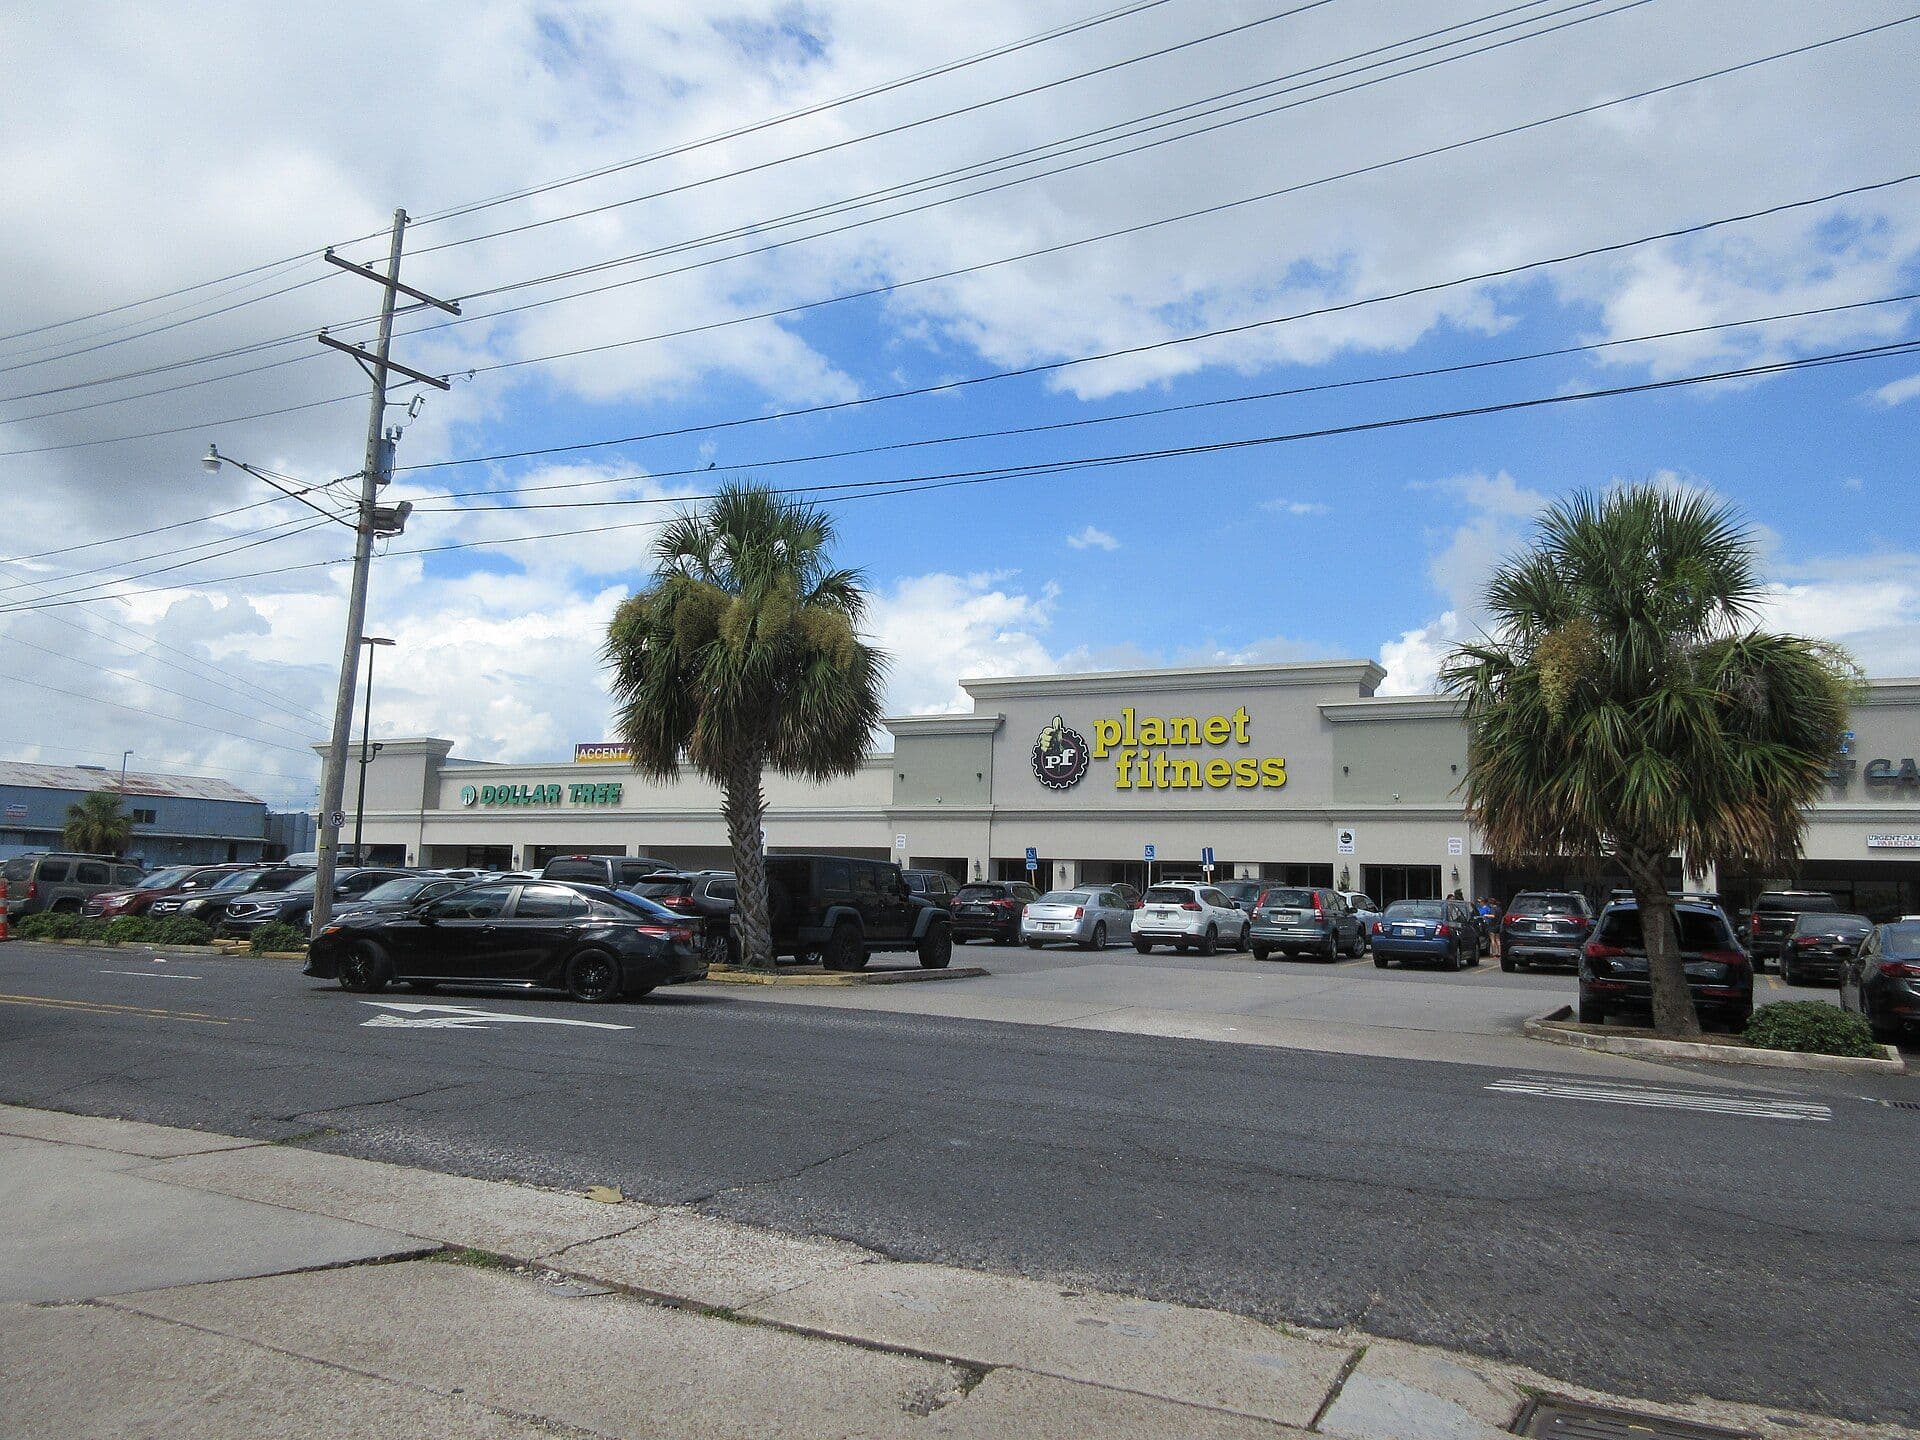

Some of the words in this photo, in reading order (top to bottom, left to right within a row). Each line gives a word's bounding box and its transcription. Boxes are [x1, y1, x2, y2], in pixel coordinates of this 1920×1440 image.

[1093, 706, 1250, 758] planet
[579, 747, 624, 759] ACCENT
[1045, 748, 1076, 769] pf
[1115, 749, 1288, 788] fitness
[480, 783, 562, 805] DOLLAR
[568, 782, 623, 804] TREE
